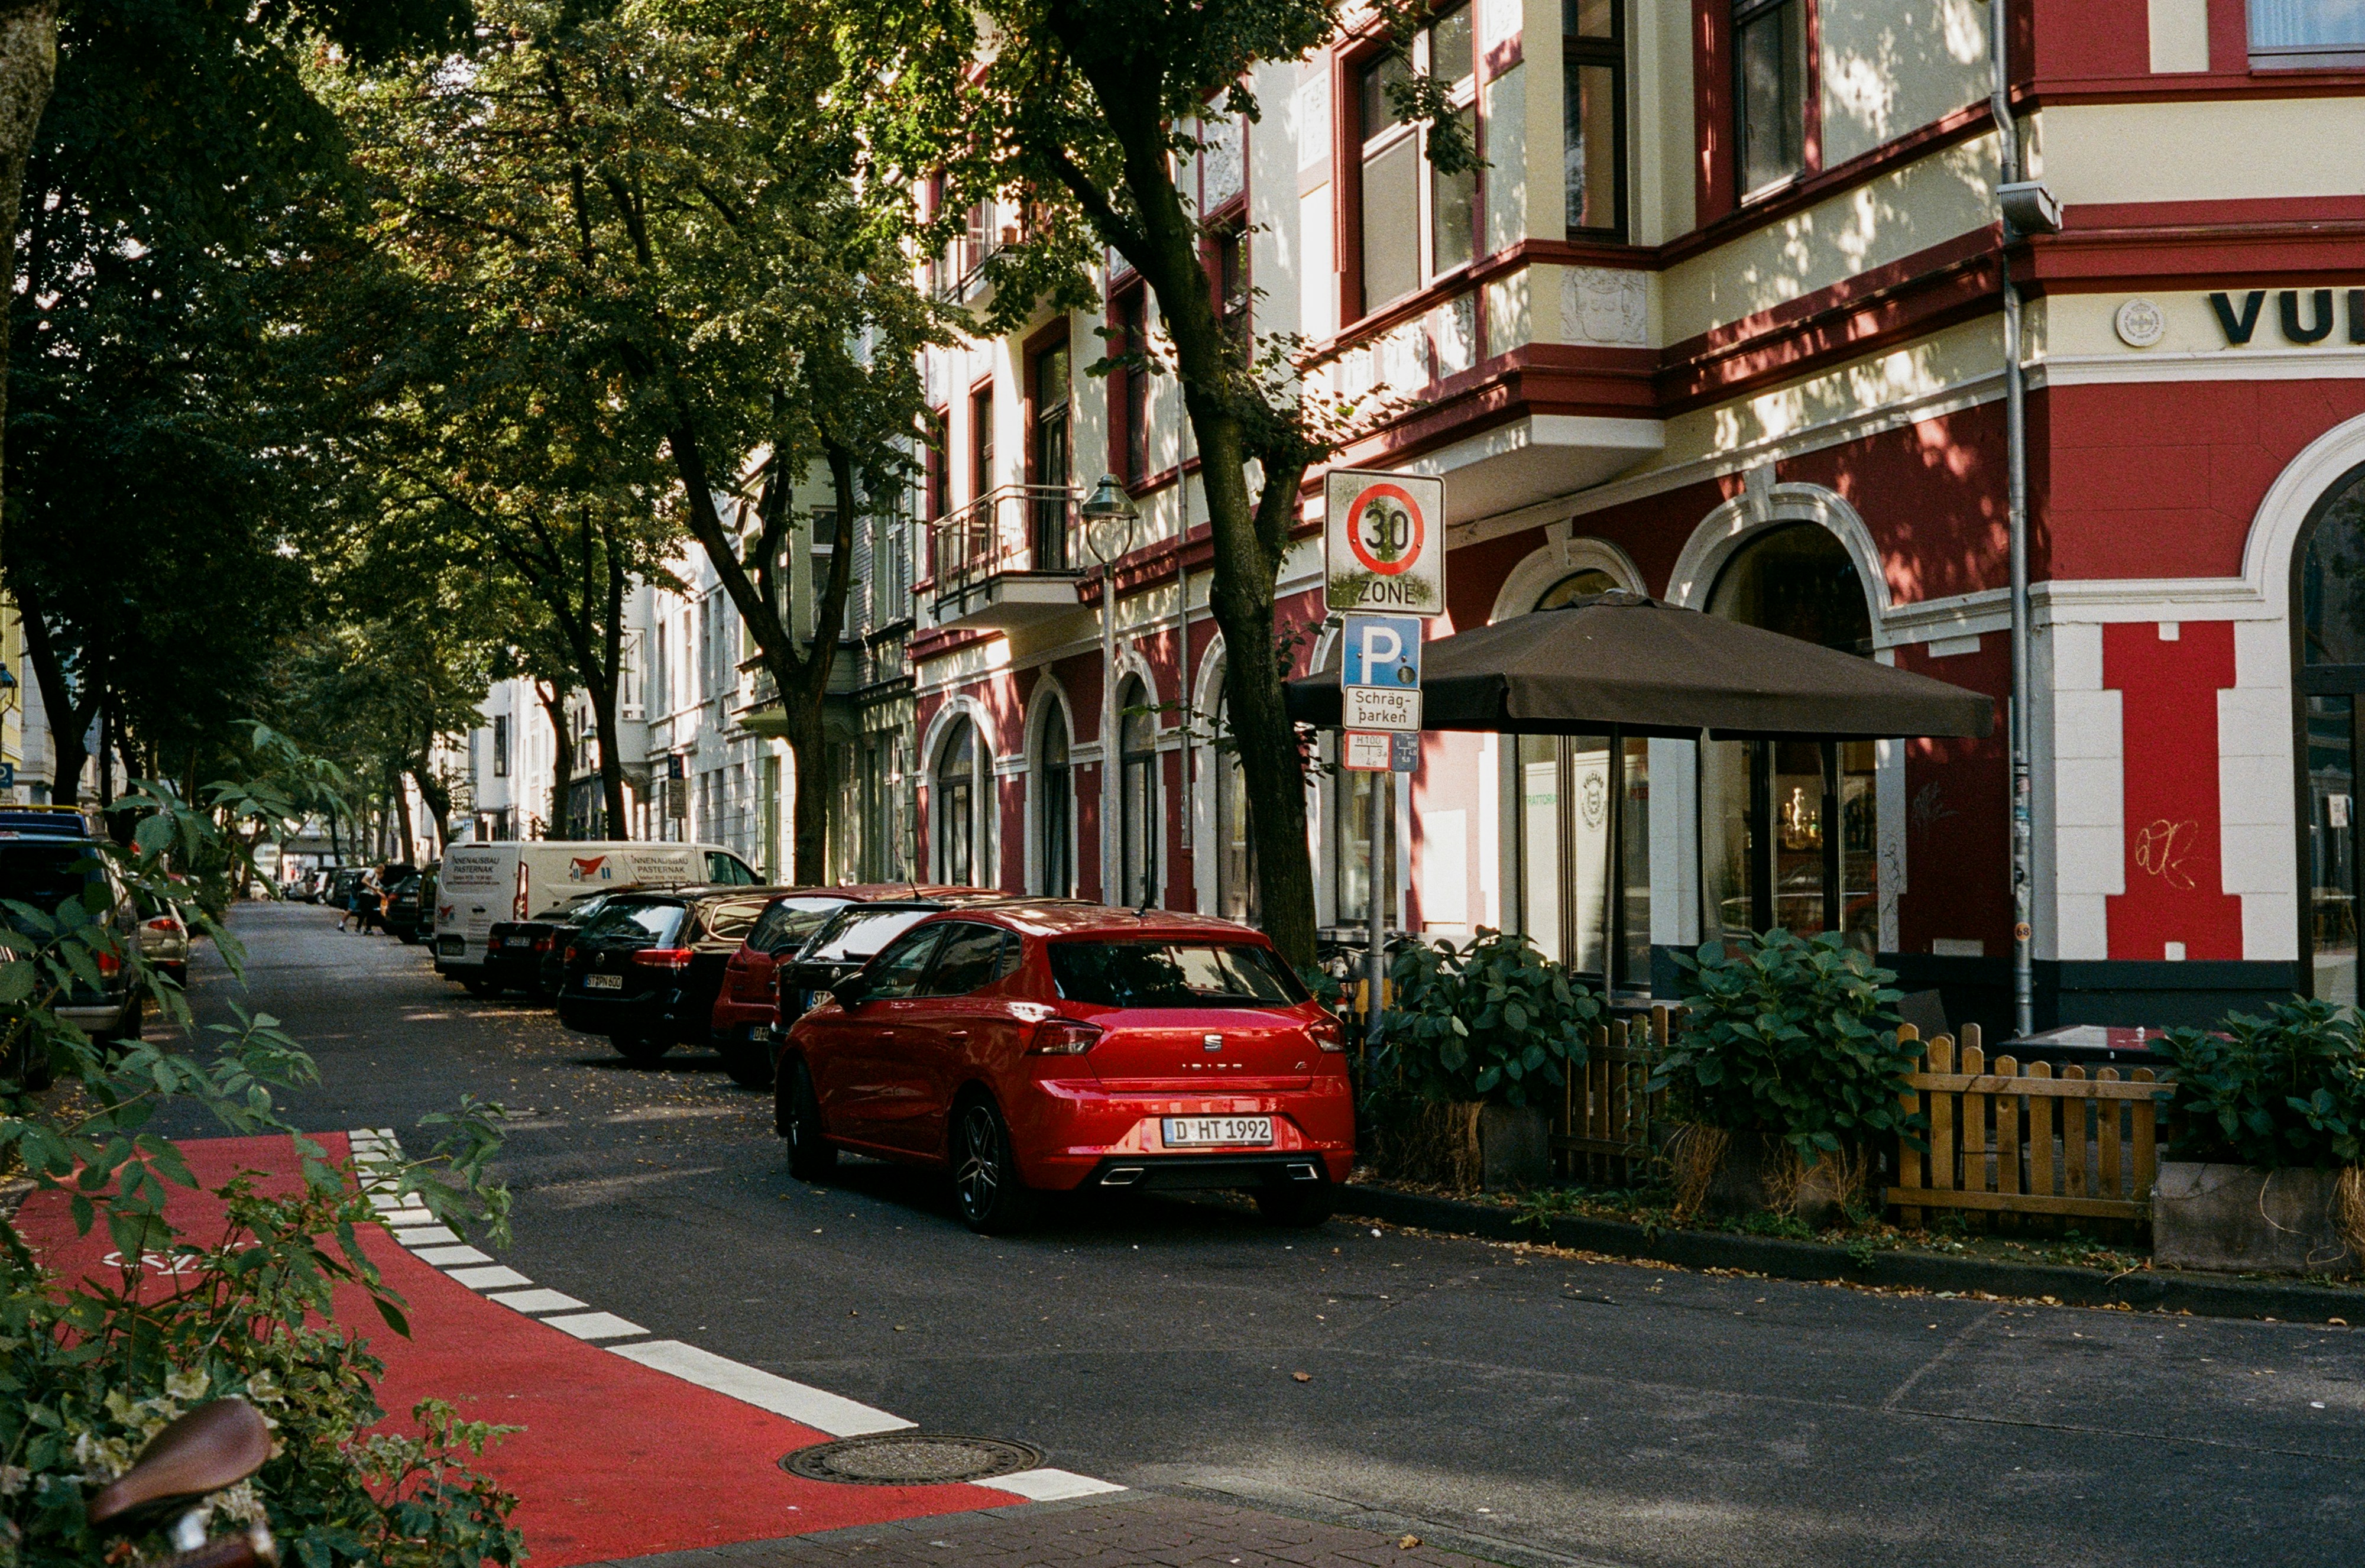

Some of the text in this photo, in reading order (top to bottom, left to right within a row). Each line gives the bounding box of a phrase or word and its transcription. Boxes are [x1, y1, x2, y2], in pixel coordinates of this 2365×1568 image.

[1365, 508, 1408, 550] 30
[1358, 580, 1416, 604] ZONE
[1362, 626, 1402, 685] P
[1356, 691, 1411, 708] Schräg-
[1359, 710, 1407, 724] parken
[813, 992, 825, 1005] ST
[1175, 1120, 1269, 1139] D HT 1992
